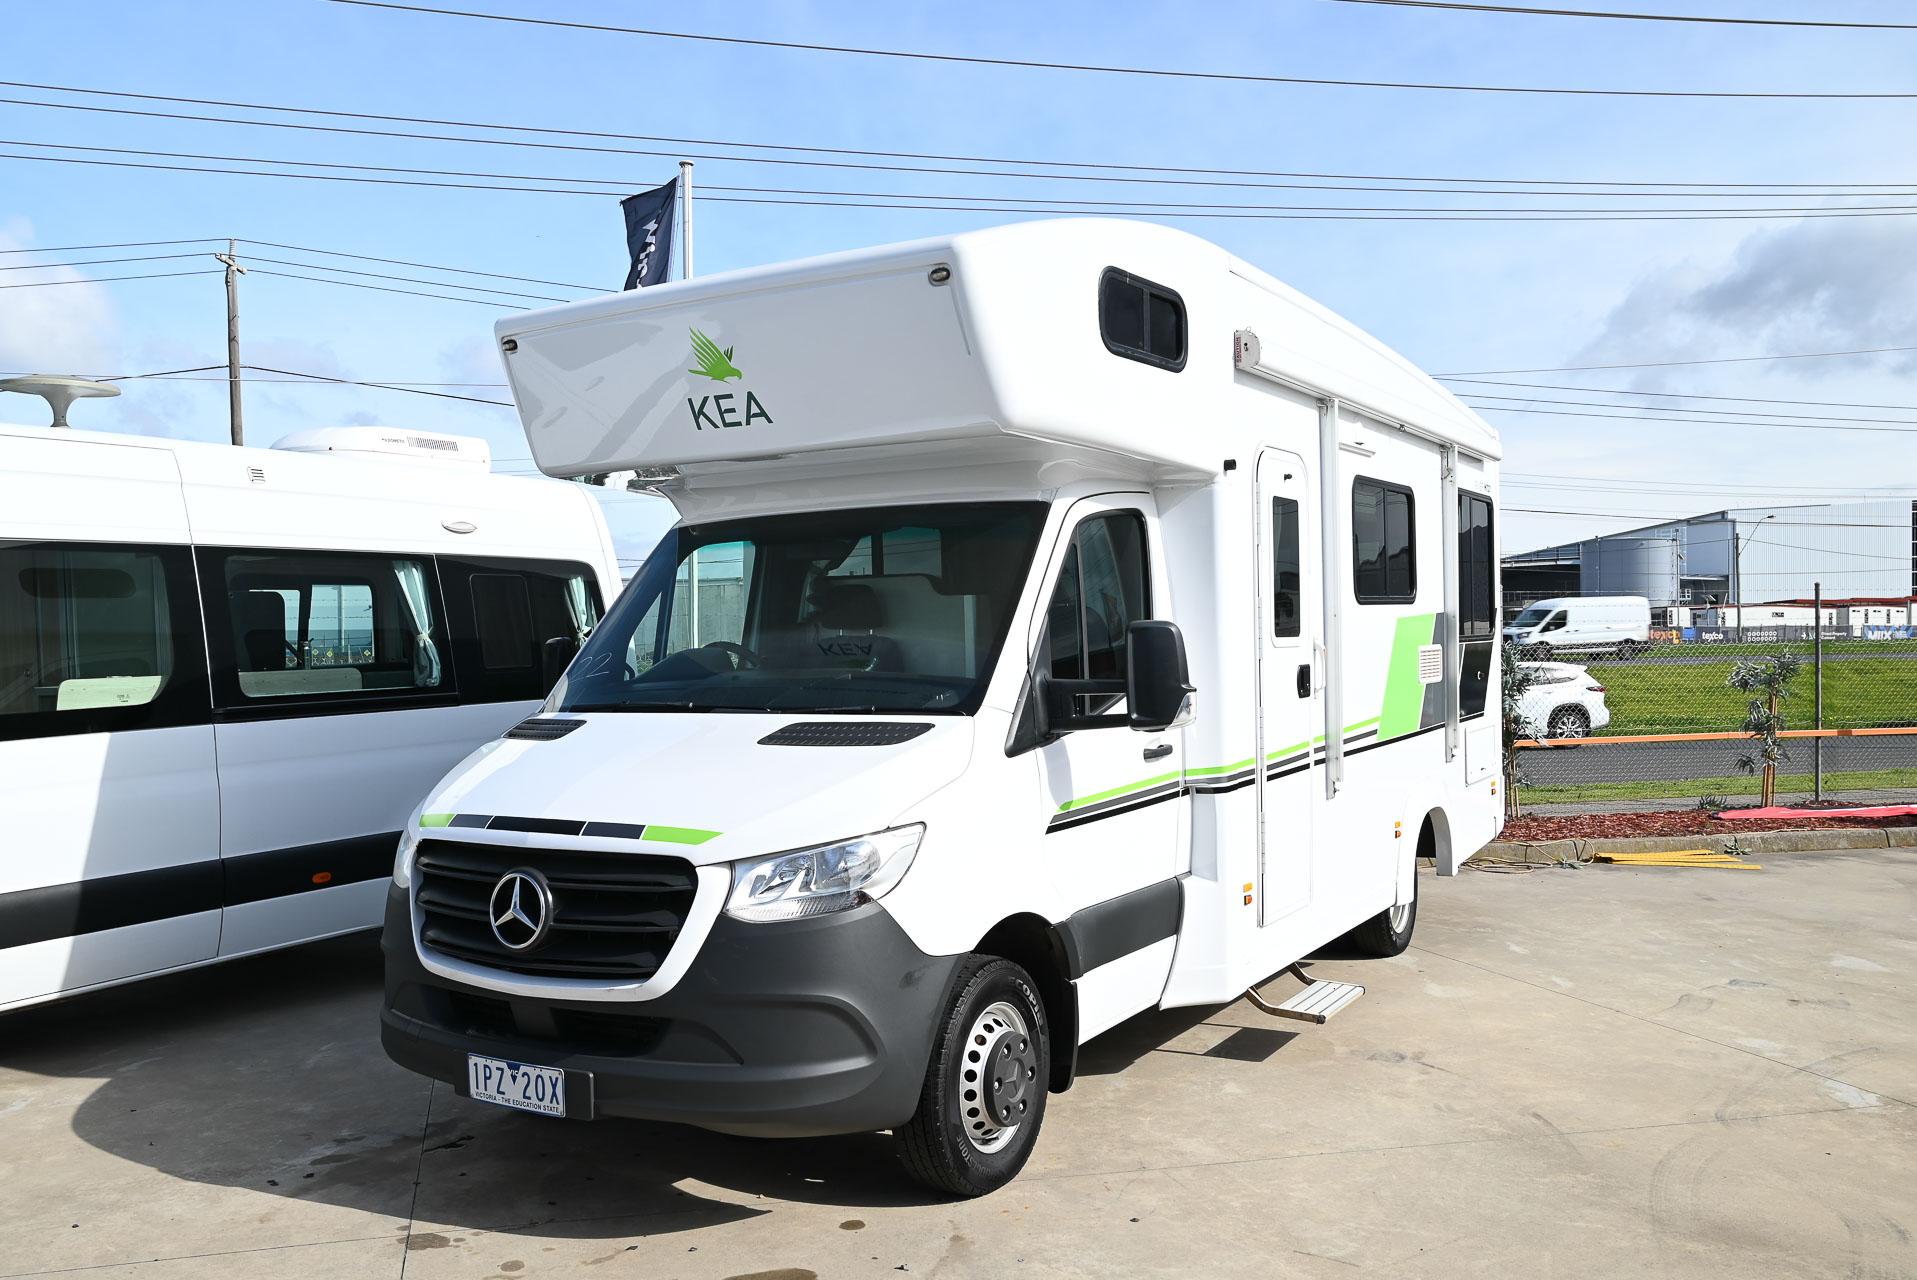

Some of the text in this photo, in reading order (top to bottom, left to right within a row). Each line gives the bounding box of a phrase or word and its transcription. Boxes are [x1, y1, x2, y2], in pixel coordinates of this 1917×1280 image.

[687, 391, 774, 431] KEA
[1702, 631, 1724, 642] texco
[473, 1062, 560, 1105] 1PZ 20X
[475, 1090, 497, 1101] VICTORIA
[512, 1099, 542, 1110] EDUCATION
[543, 1104, 560, 1113] STATE
